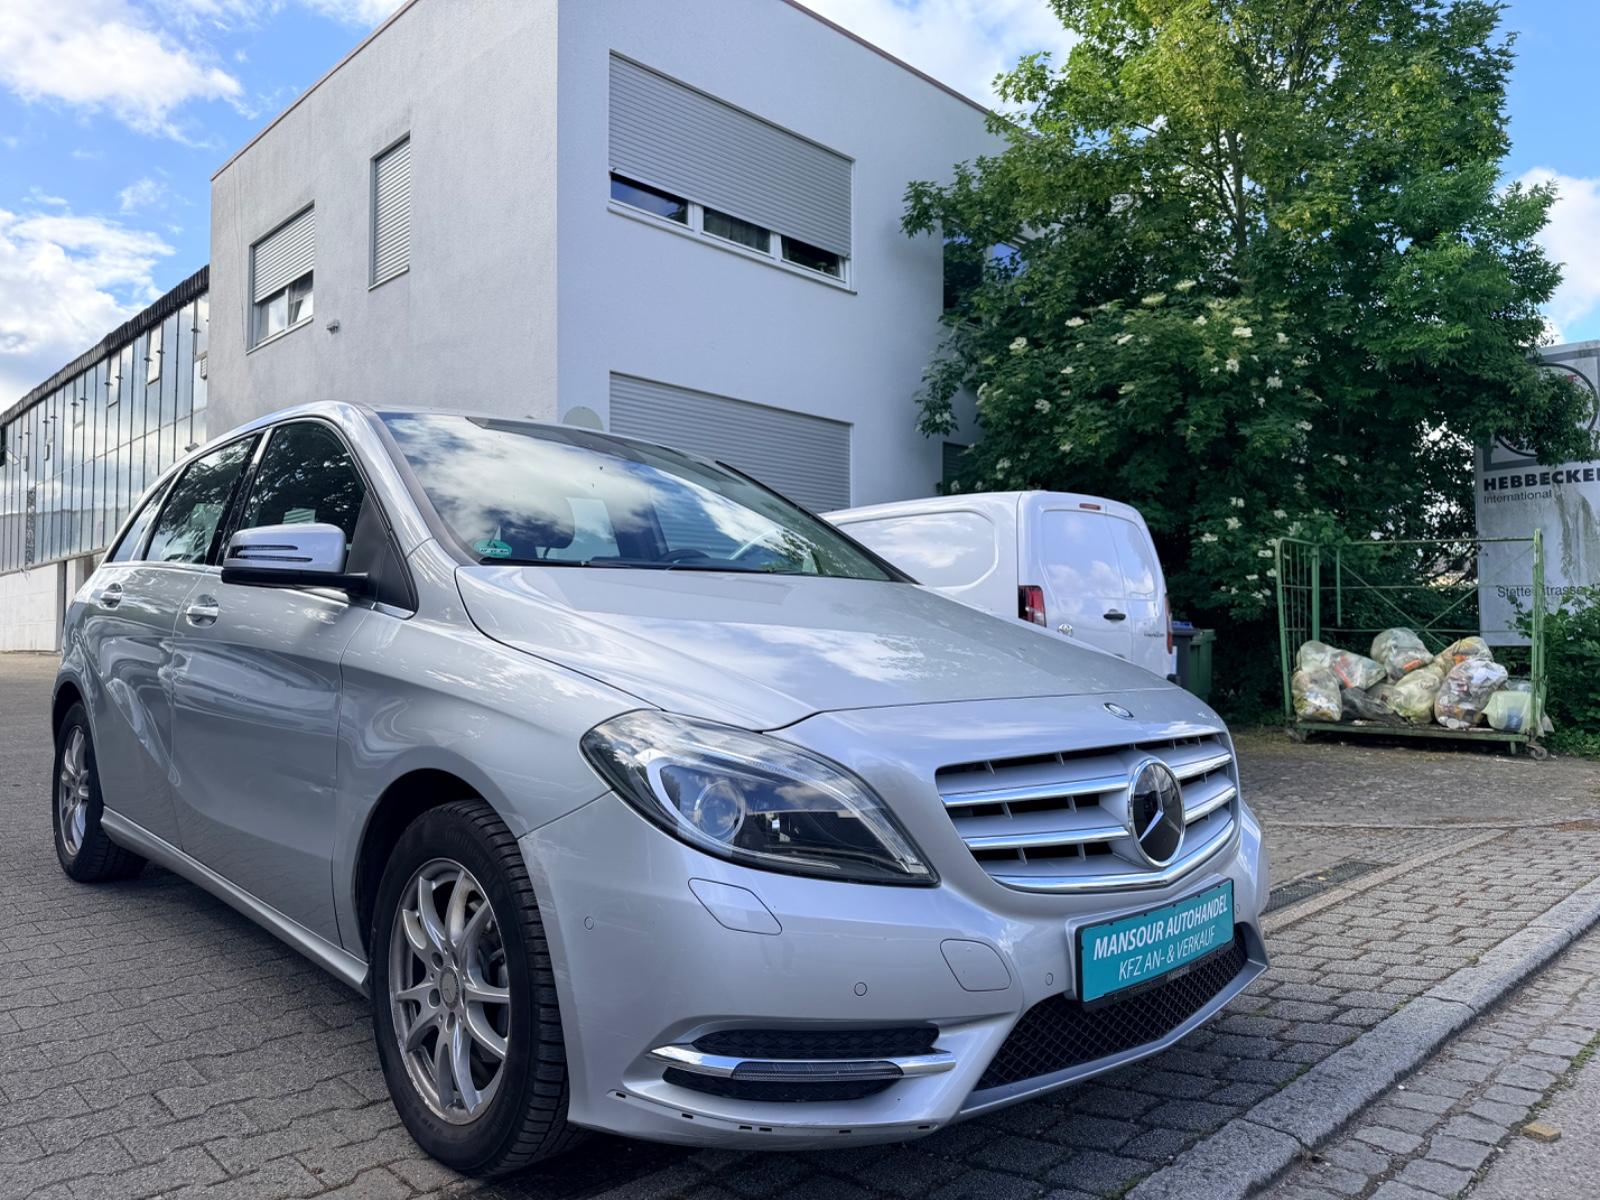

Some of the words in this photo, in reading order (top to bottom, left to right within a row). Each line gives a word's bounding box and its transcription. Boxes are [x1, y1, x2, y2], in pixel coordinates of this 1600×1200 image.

[1484, 467, 1600, 491] HEBBECKE
[1484, 489, 1552, 504] International
[1497, 585, 1533, 598] Stette
[1542, 584, 1584, 596] trasse
[1093, 921, 1164, 961] MANSOUR
[1165, 893, 1228, 939] AUTOHANDEL
[1118, 955, 1142, 982] KFZ
[1143, 951, 1165, 973] AN-
[1166, 945, 1174, 964] &
[1176, 925, 1216, 960] VERKAUF
